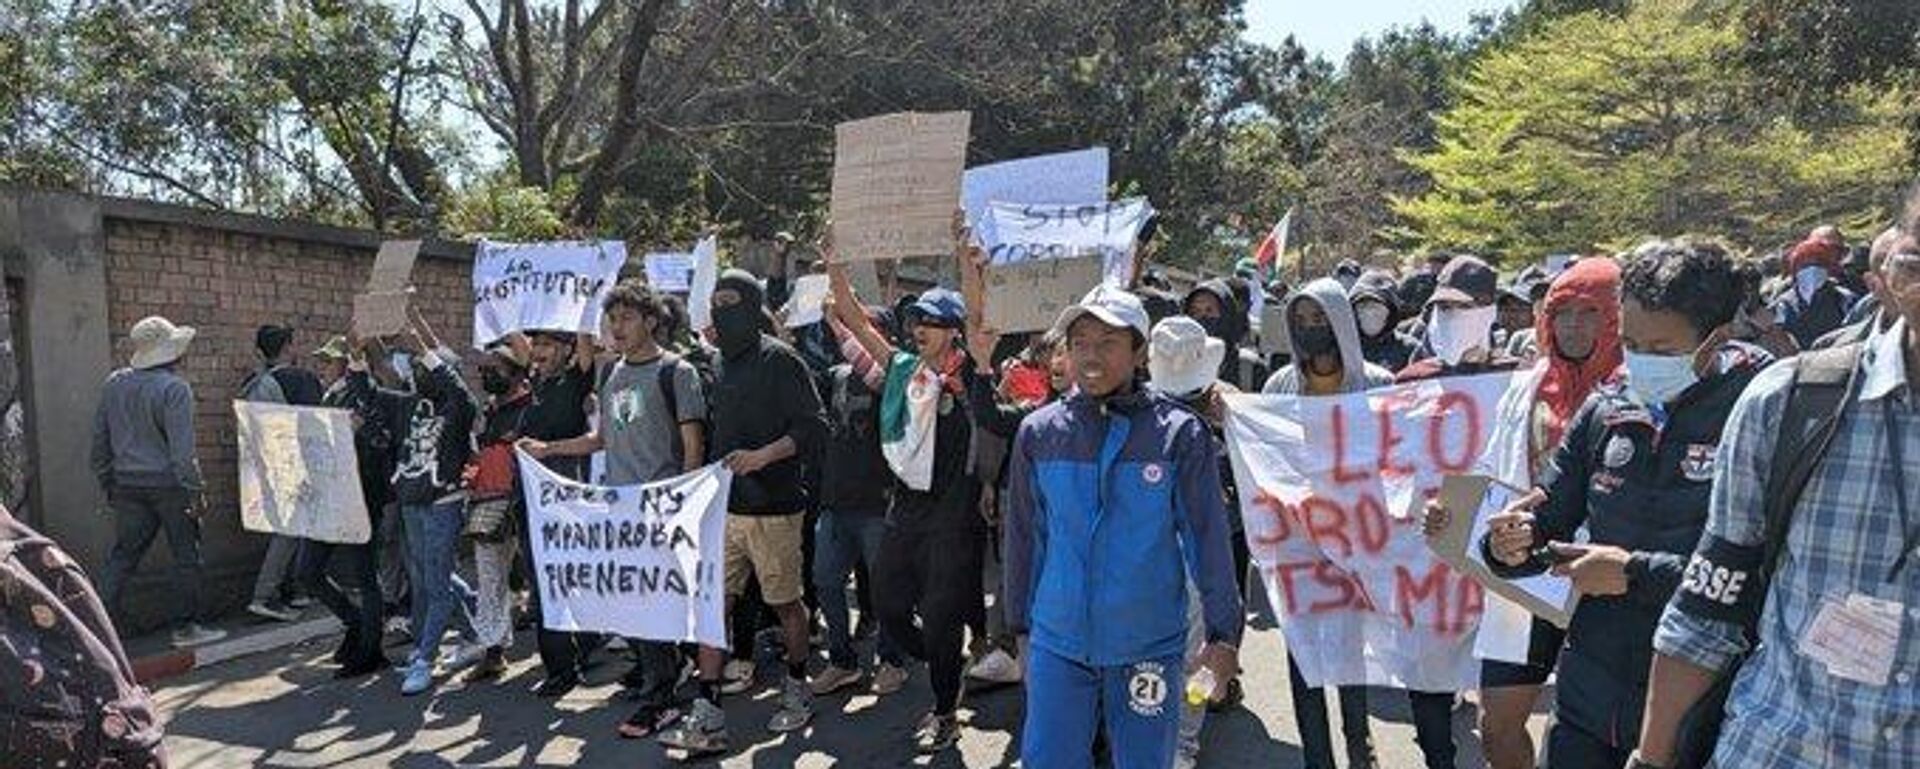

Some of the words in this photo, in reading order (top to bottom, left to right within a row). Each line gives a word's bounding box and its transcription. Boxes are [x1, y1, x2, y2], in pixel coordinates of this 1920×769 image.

[1329, 390, 1480, 483] LEO
[638, 485, 685, 516] NY
[541, 519, 696, 552] MPANDROBA
[1135, 677, 1158, 700] 21
